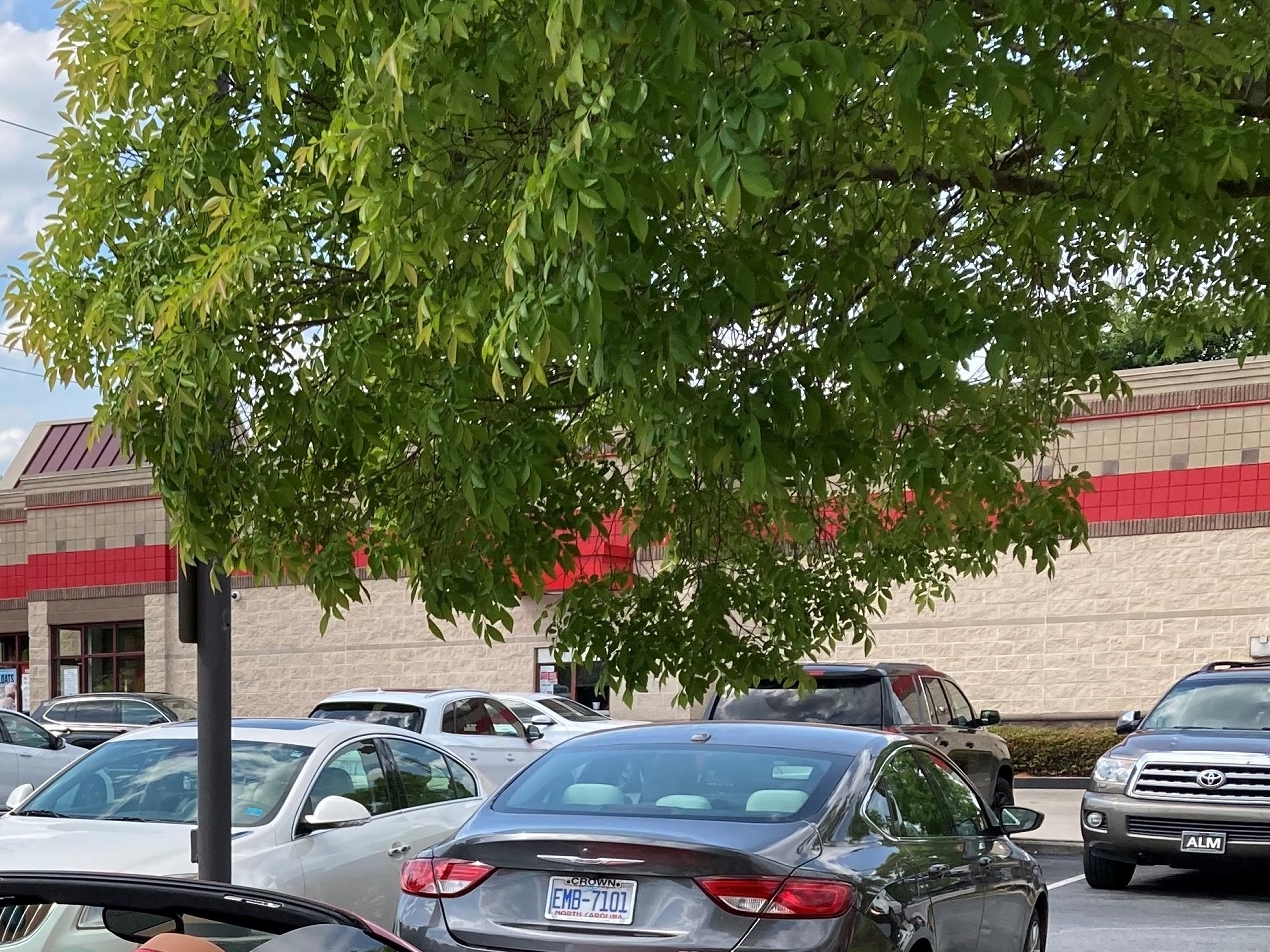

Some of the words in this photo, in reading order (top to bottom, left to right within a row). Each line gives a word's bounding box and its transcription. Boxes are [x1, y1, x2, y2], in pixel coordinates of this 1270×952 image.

[1186, 836, 1221, 849] ALM
[571, 877, 617, 887] CROWN
[552, 887, 628, 913] EMB-7101
